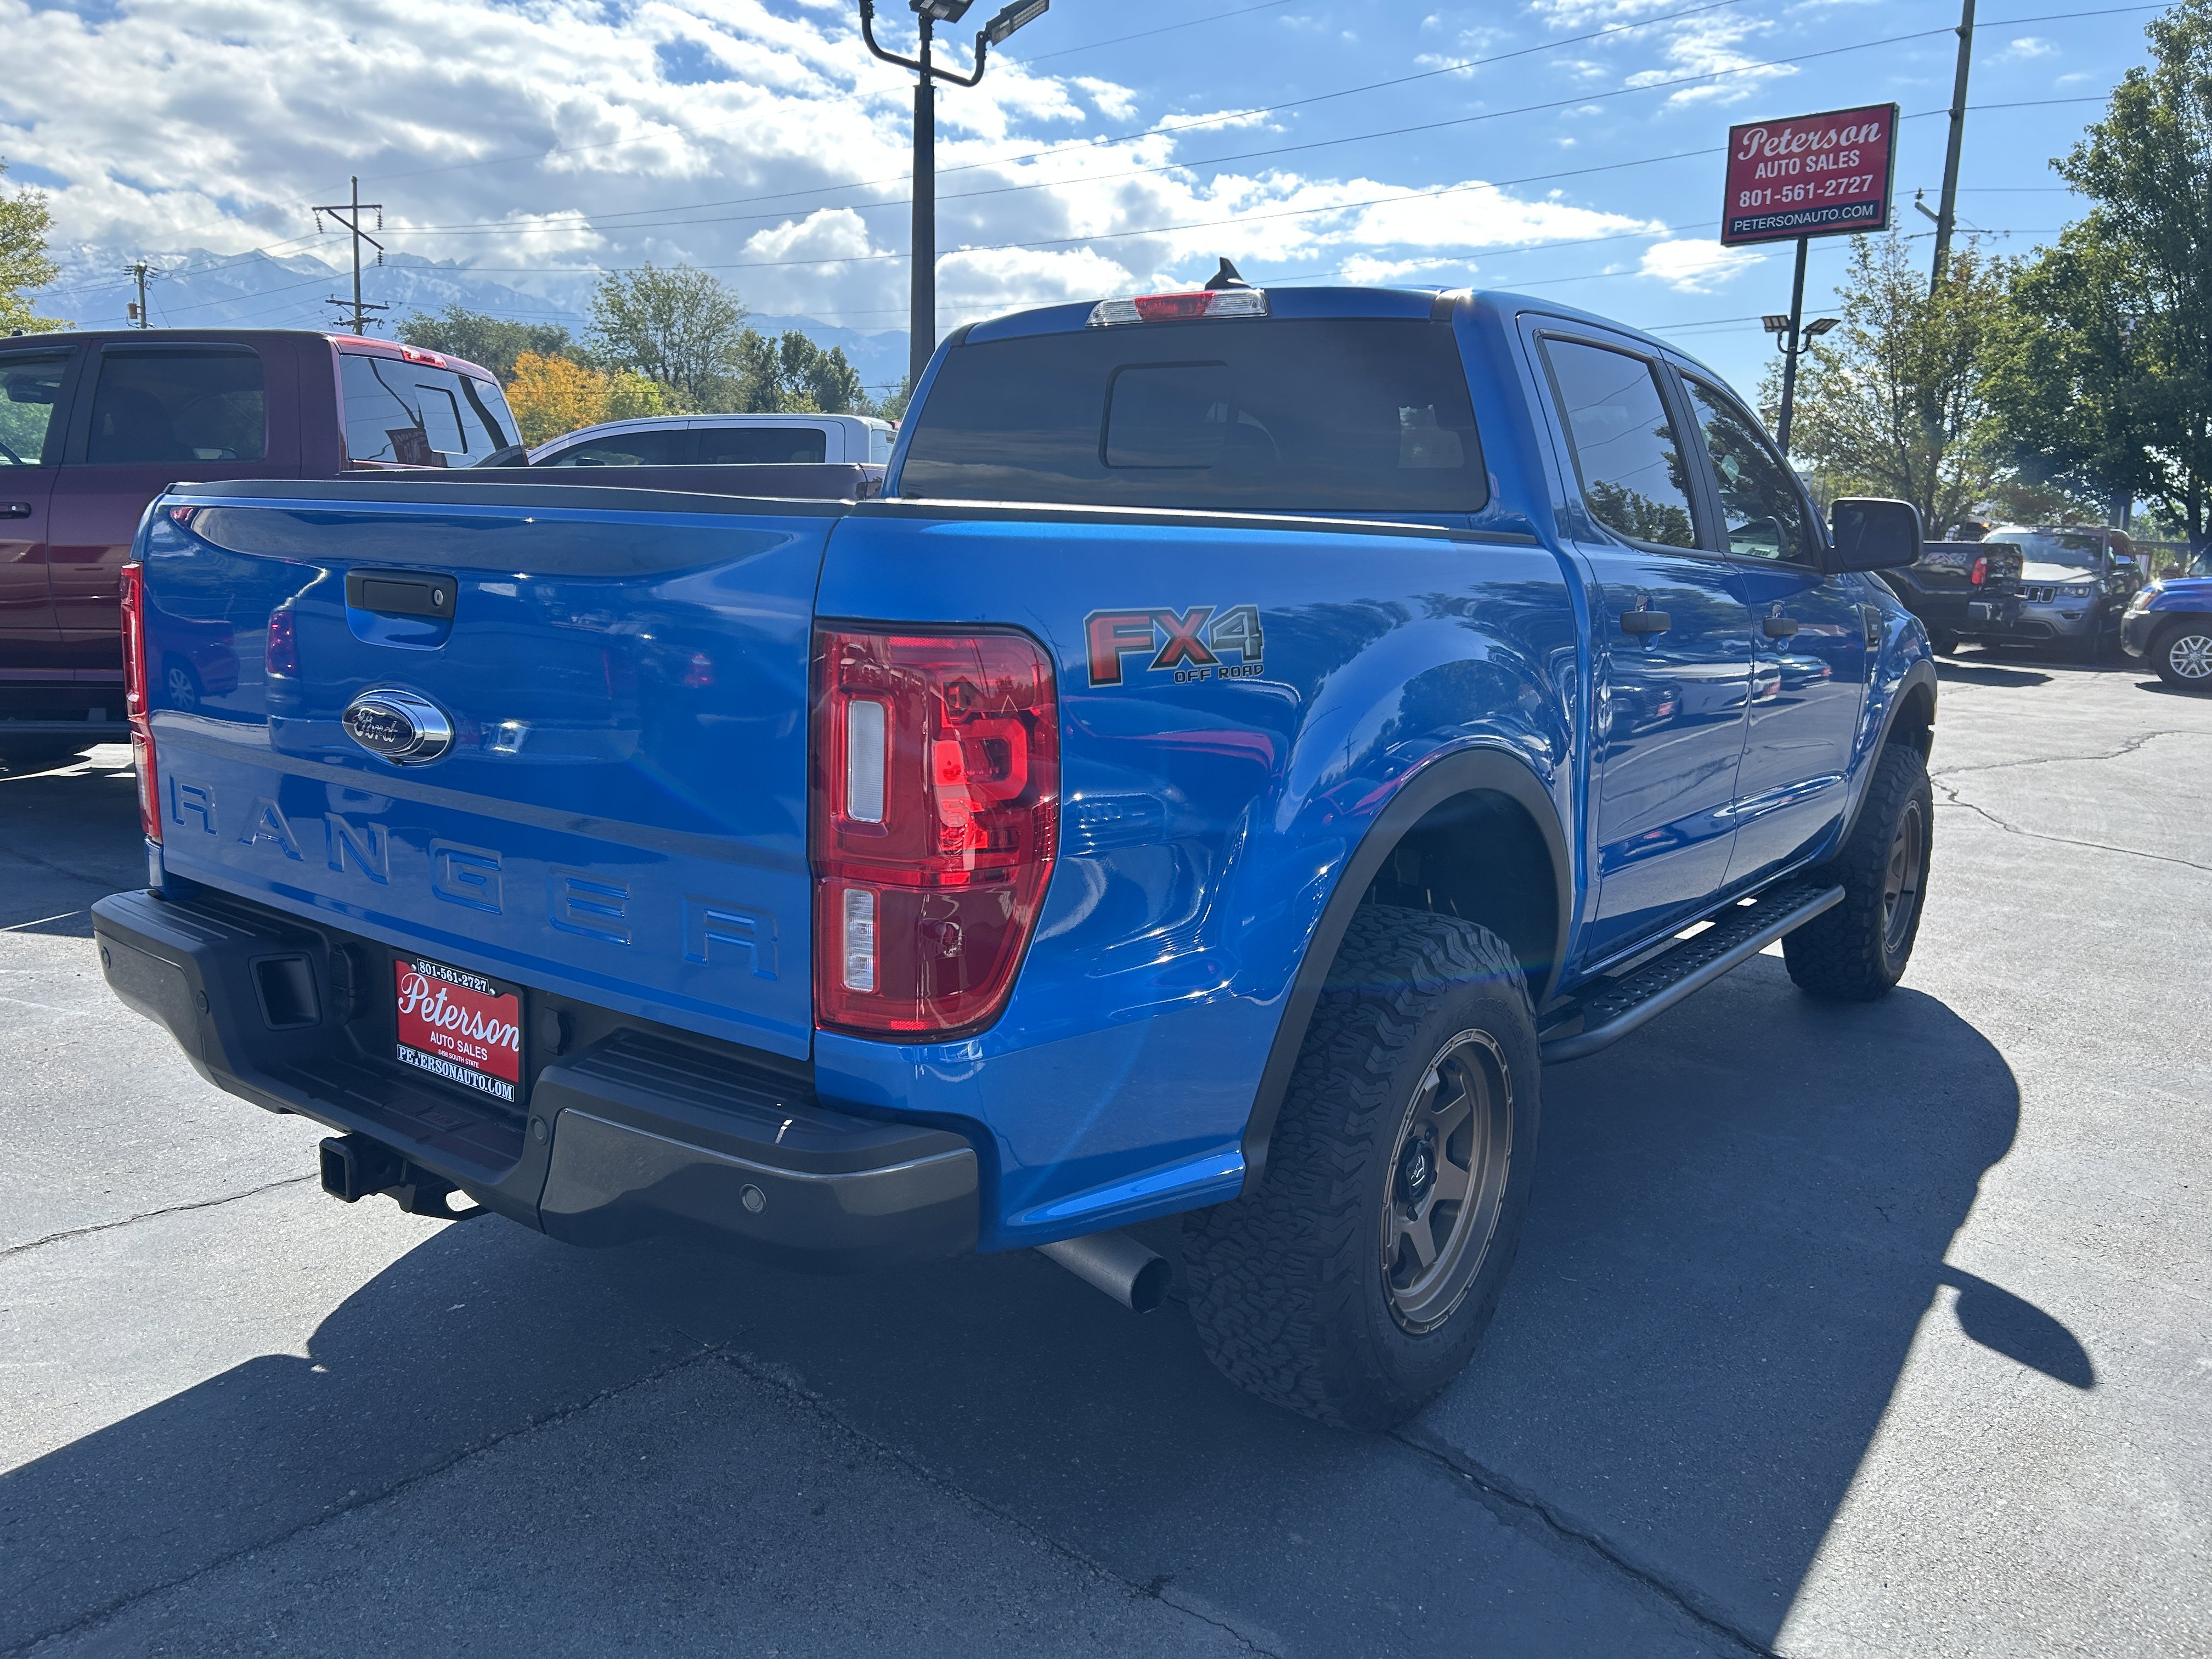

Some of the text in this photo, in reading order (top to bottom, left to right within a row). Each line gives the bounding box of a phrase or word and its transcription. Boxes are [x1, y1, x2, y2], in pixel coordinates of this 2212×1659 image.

[1737, 122, 1882, 161] Peterson
[1754, 149, 1860, 179] AUTO SALES
[1739, 174, 1874, 208] 801-561-2727
[1734, 205, 1874, 232] PETERSONAUTO.COM
[1083, 604, 1264, 689] FX4
[1174, 664, 1265, 684] OFF ROAD
[354, 707, 398, 743] Ford
[169, 772, 778, 981] RANGER
[419, 961, 487, 992] 801-561-2727
[398, 972, 520, 1052] Peterson
[430, 1031, 488, 1060] AUTO SALES
[449, 1052, 465, 1063] SOUTH
[465, 1058, 479, 1068] STATE
